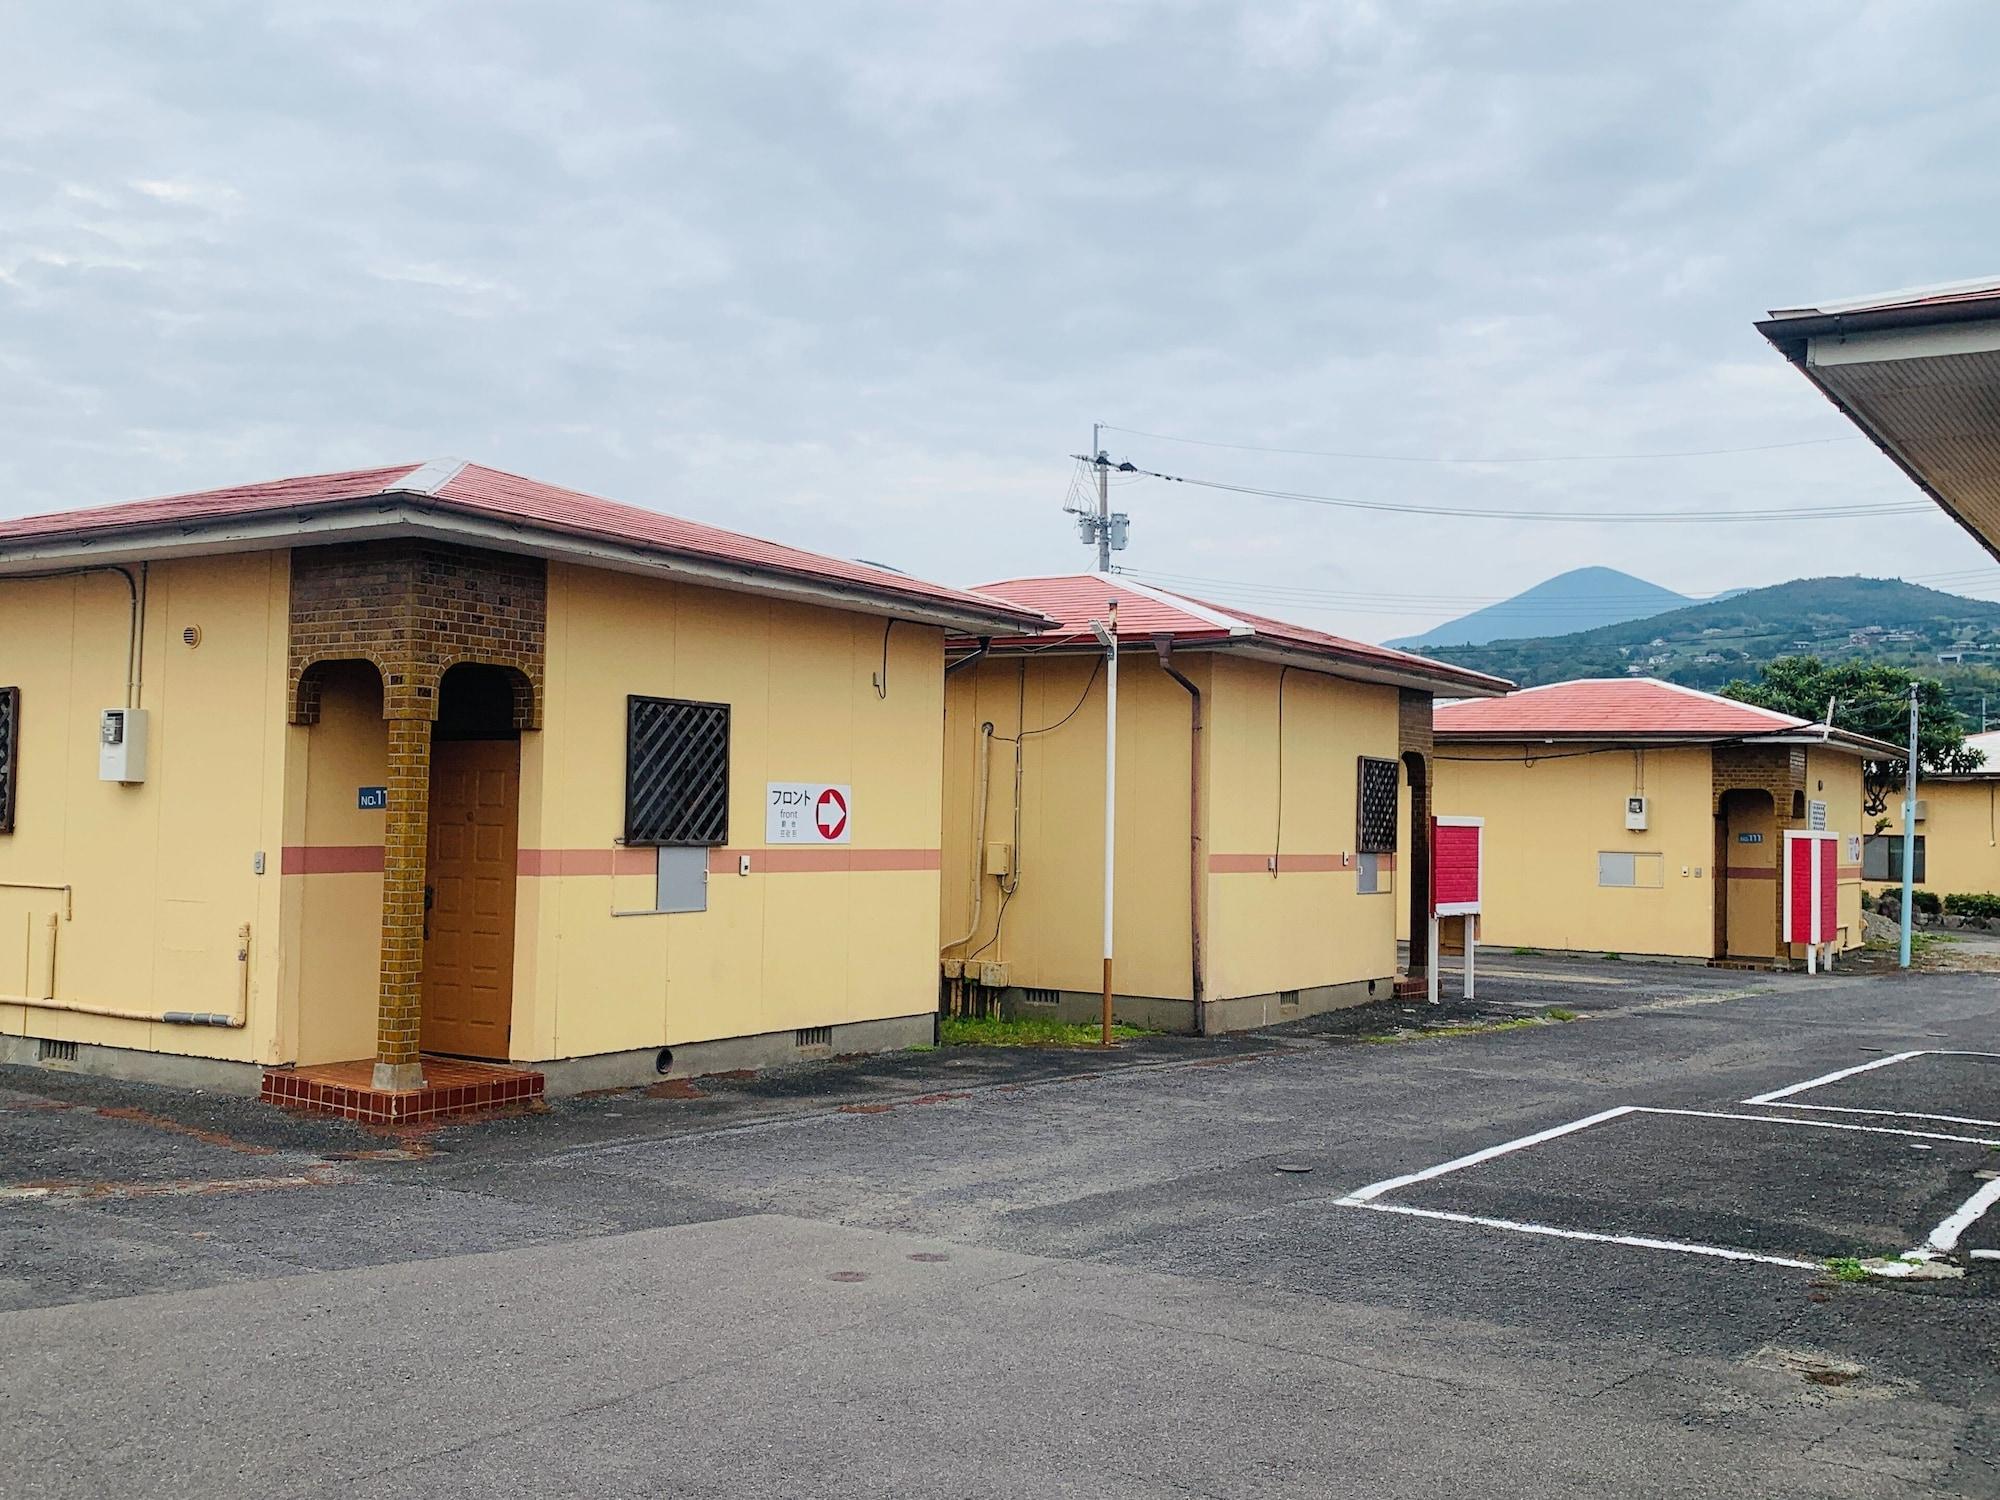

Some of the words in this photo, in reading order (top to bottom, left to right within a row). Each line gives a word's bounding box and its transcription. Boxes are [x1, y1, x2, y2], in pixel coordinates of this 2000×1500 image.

[772, 789, 811, 807] フロント
[780, 808, 798, 819] front
